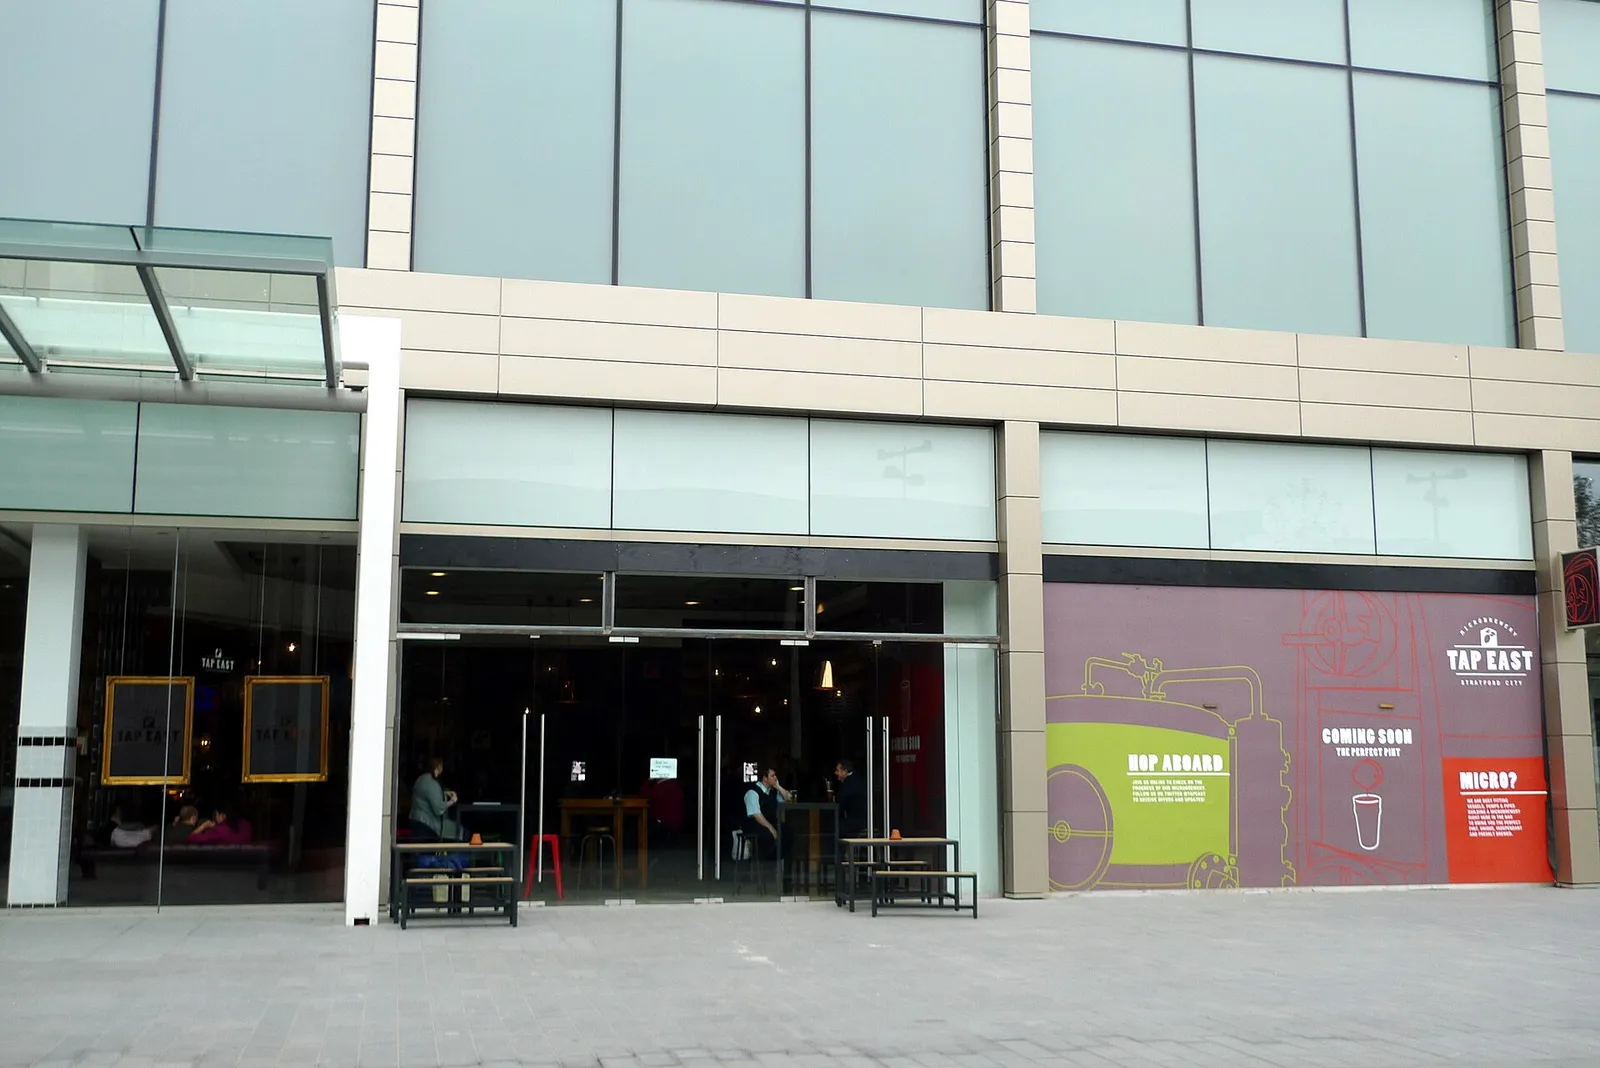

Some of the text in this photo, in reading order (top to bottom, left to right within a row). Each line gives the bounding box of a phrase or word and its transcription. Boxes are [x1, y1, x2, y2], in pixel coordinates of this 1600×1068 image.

[1460, 617, 1518, 636] MICROBREWERY
[1446, 650, 1533, 670] TAP EAST
[146, 730, 180, 743] EAT
[1322, 728, 1412, 744] COMING SOON
[1336, 747, 1400, 757] THE PERFECT PINT
[1128, 754, 1223, 771] HOP ABOARD
[1459, 772, 1518, 789] MICRO?
